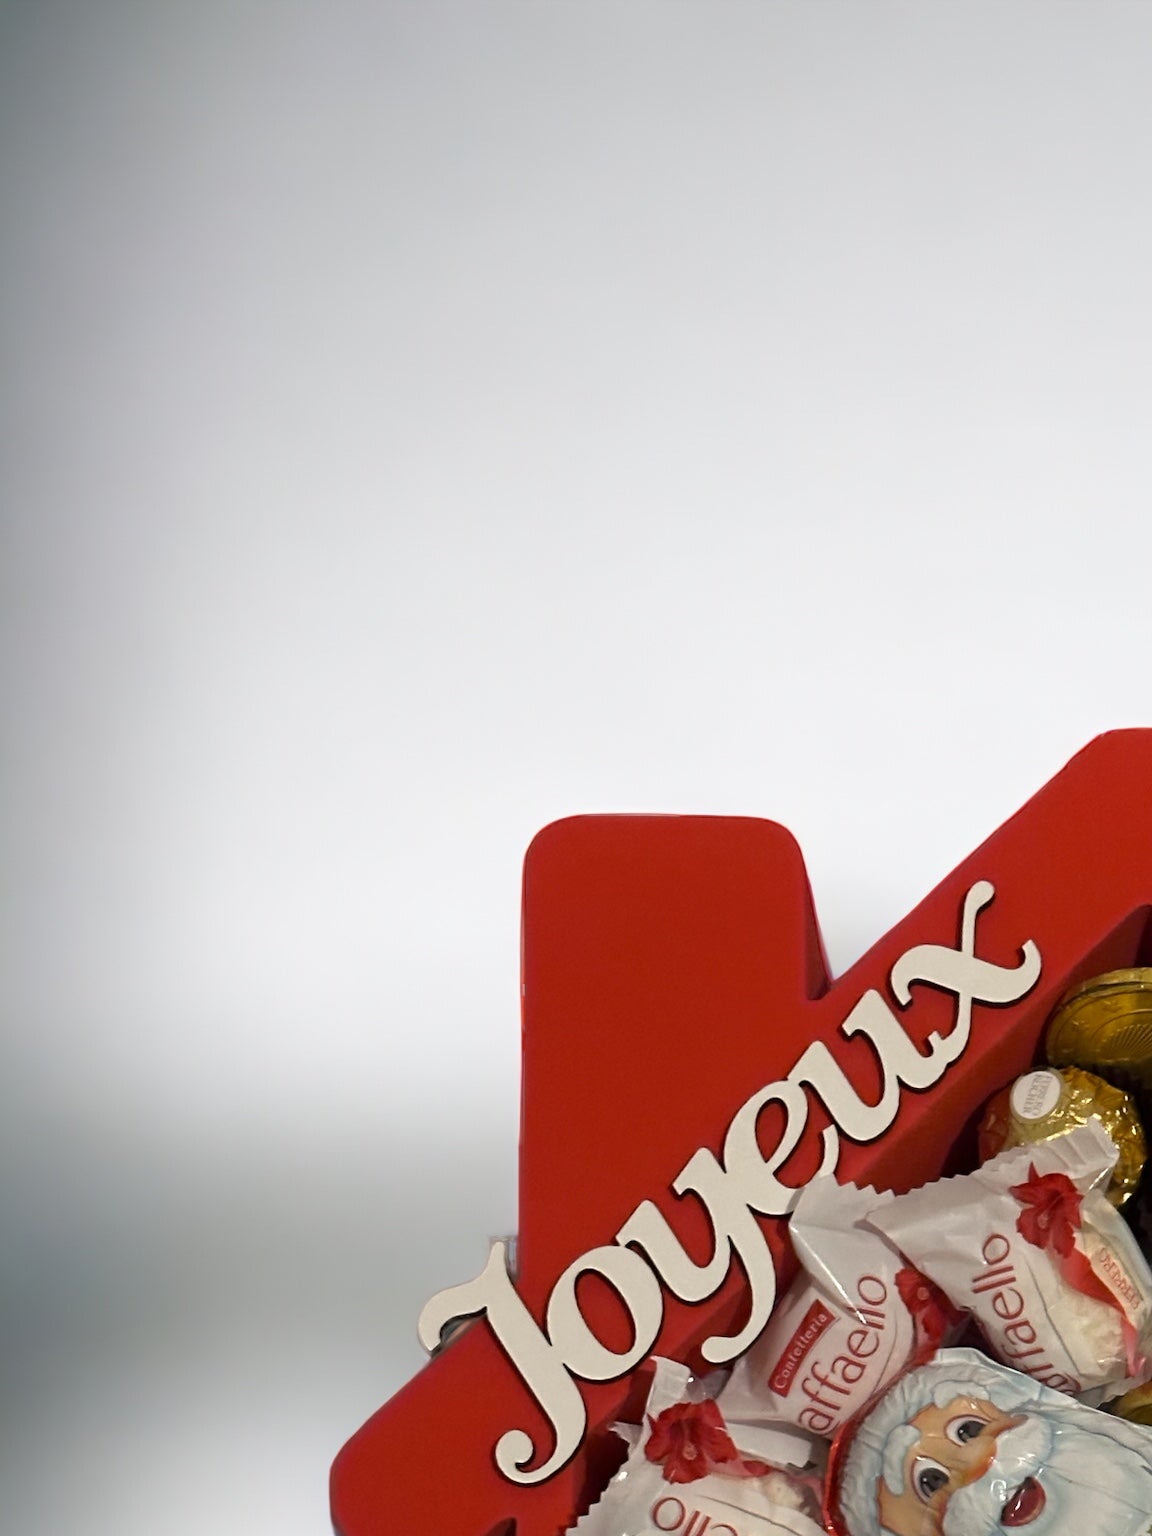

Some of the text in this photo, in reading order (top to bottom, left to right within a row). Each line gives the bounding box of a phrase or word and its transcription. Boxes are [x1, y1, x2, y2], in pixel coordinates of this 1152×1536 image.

[417, 880, 1041, 1485] Joyeux
[798, 1275, 888, 1436] affaello
[972, 1233, 1082, 1396] affaello
